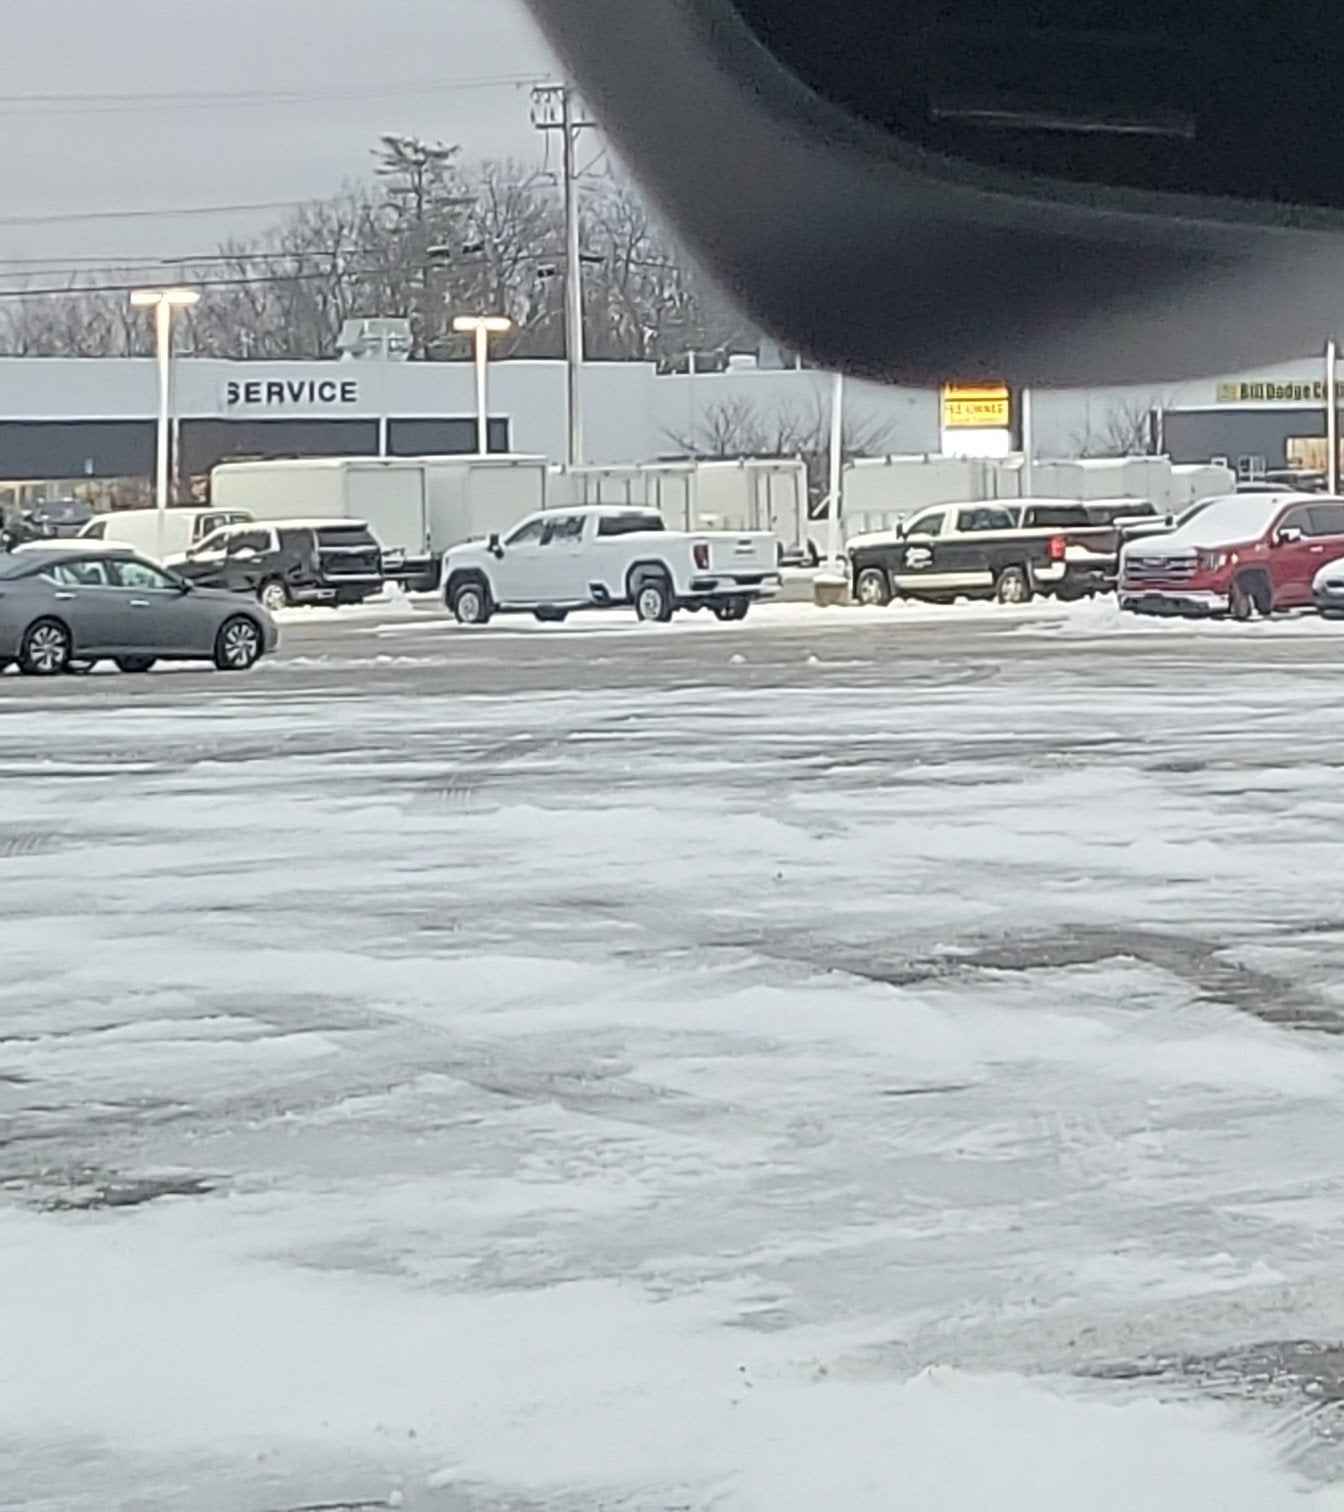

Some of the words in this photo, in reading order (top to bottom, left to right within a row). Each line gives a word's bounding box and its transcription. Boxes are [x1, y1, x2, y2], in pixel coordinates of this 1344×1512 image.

[227, 380, 358, 404] SERVICE
[1240, 383, 1263, 400] Bill
[1266, 382, 1311, 400] Dodge
